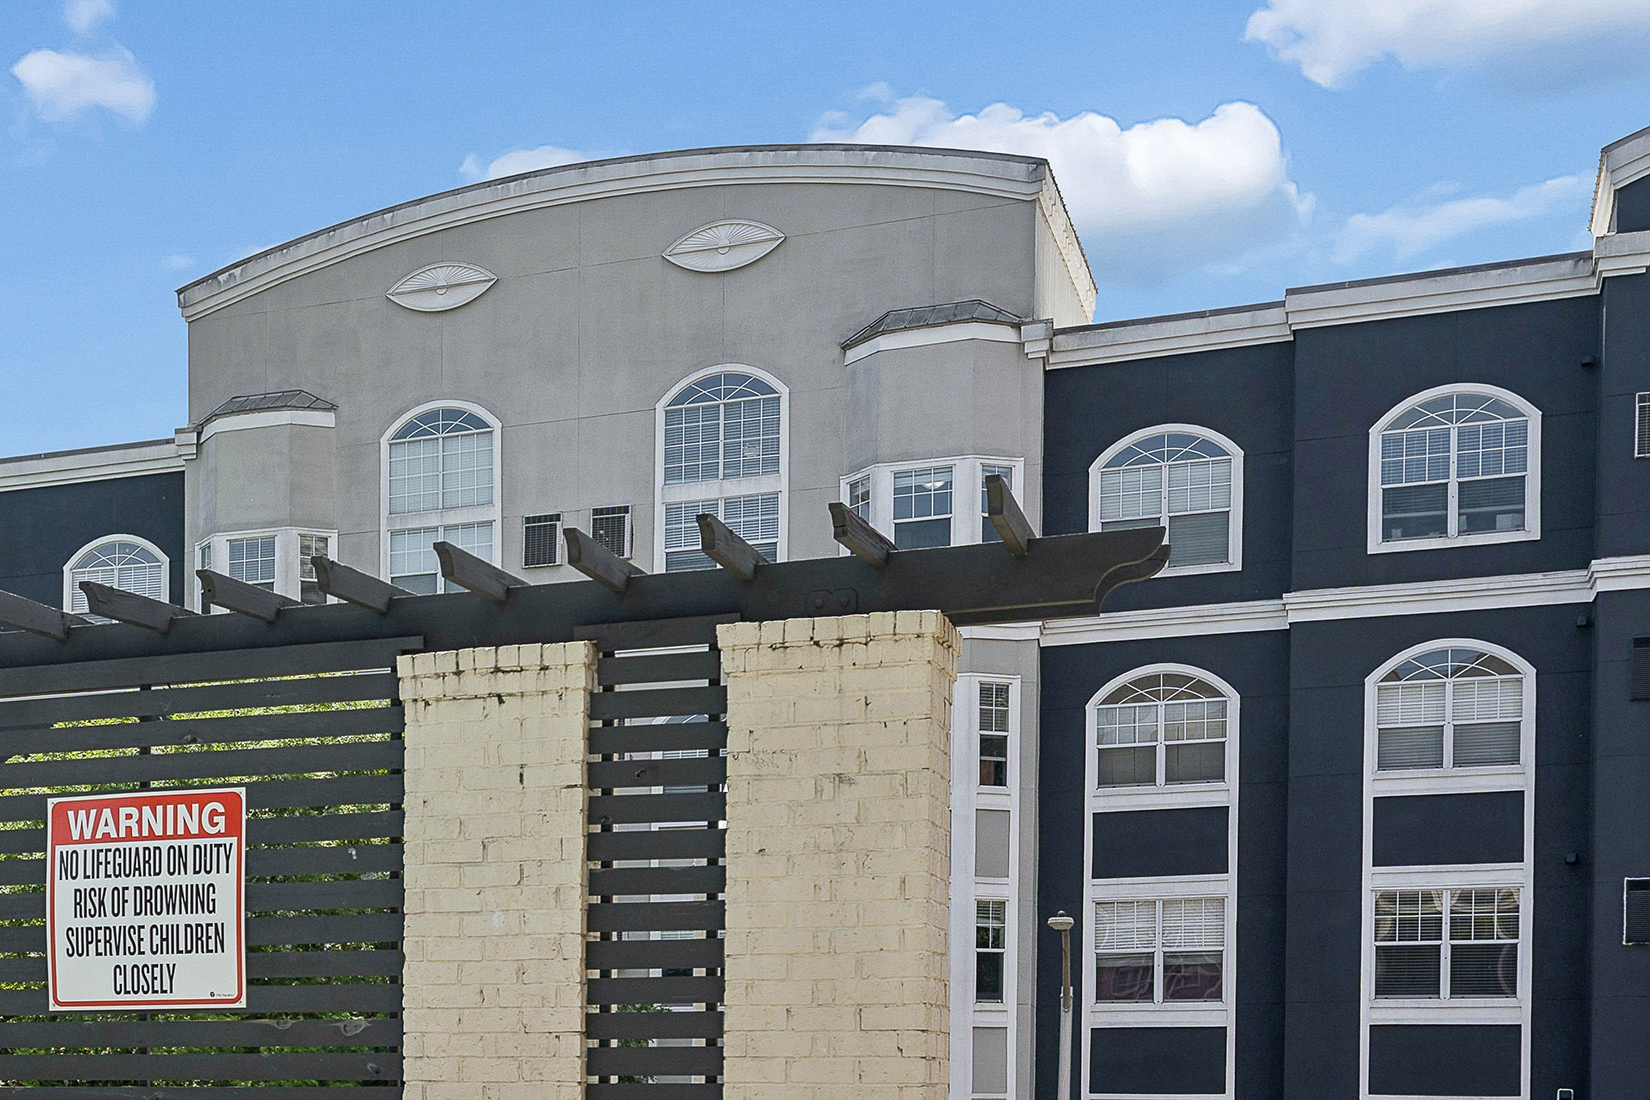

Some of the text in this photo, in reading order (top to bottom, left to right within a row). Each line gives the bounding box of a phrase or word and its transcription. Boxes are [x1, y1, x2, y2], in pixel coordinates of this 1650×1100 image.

[67, 801, 226, 841] WARNING
[59, 843, 233, 881] NO LIFEGUARD ON DUTY
[73, 883, 216, 918] RISK OF DROWNING
[66, 922, 225, 958] SUPERVISE CHILDREN
[113, 963, 176, 995] CLOSELY
